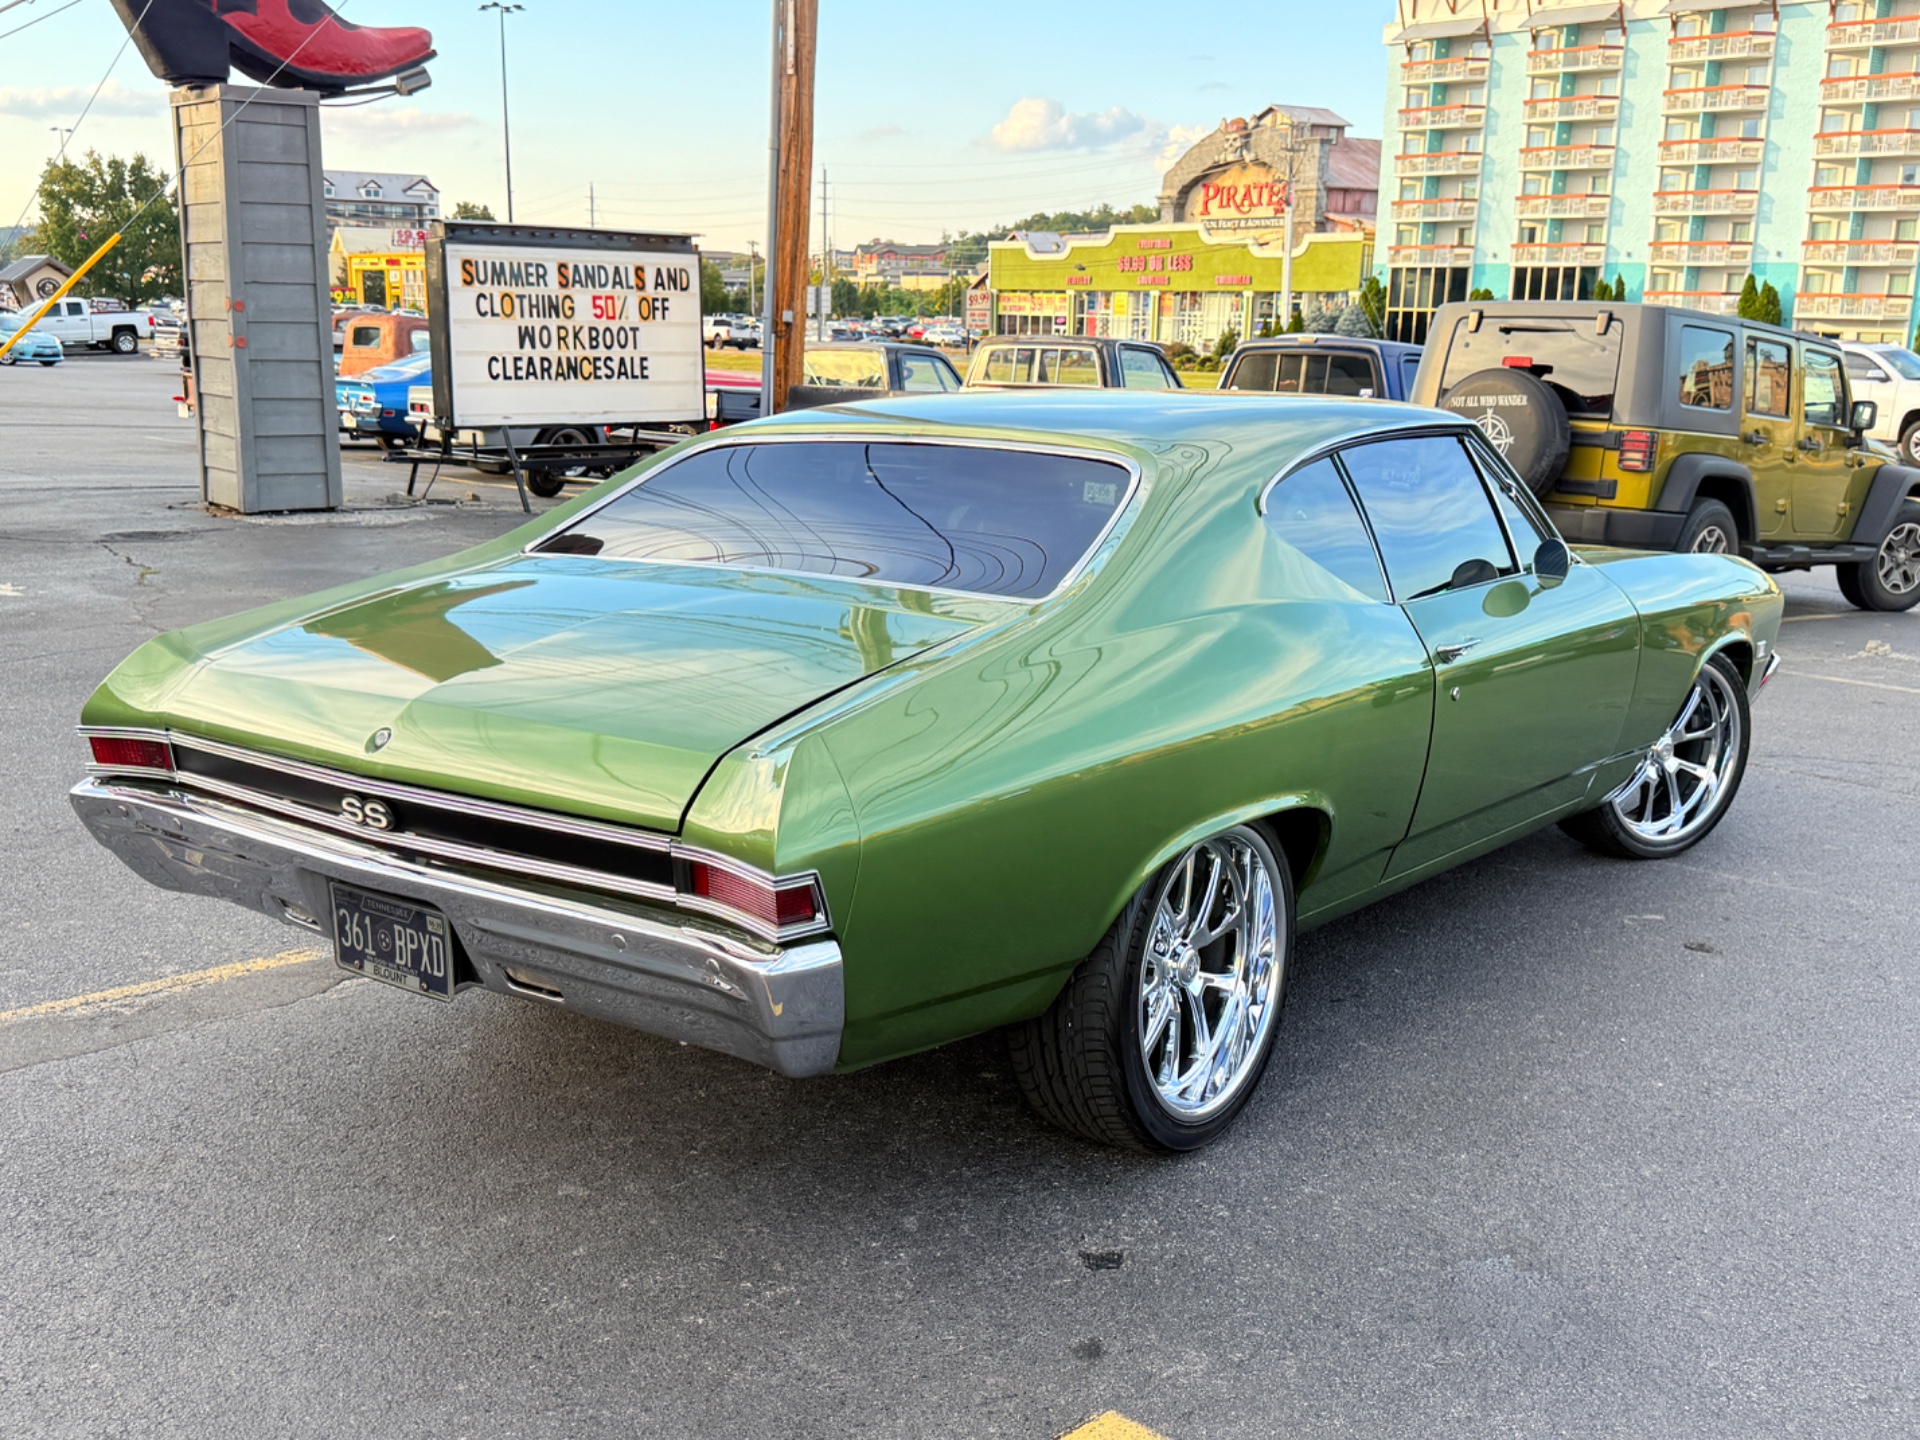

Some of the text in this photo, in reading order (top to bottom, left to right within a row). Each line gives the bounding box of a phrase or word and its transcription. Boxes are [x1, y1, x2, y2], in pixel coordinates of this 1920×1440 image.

[461, 258, 691, 292] SUMMER SANDALS AND
[1117, 254, 1193, 272] $9.99 OR LESS
[476, 292, 576, 320] CLOTHING
[639, 295, 670, 321] OFF
[1451, 394, 1528, 407] NOT ALL WHO WANDER
[341, 796, 389, 829] SS
[366, 898, 410, 919] TENNESSEE
[339, 908, 445, 977] 361 BPXD
[373, 964, 409, 985] BLOUNT
